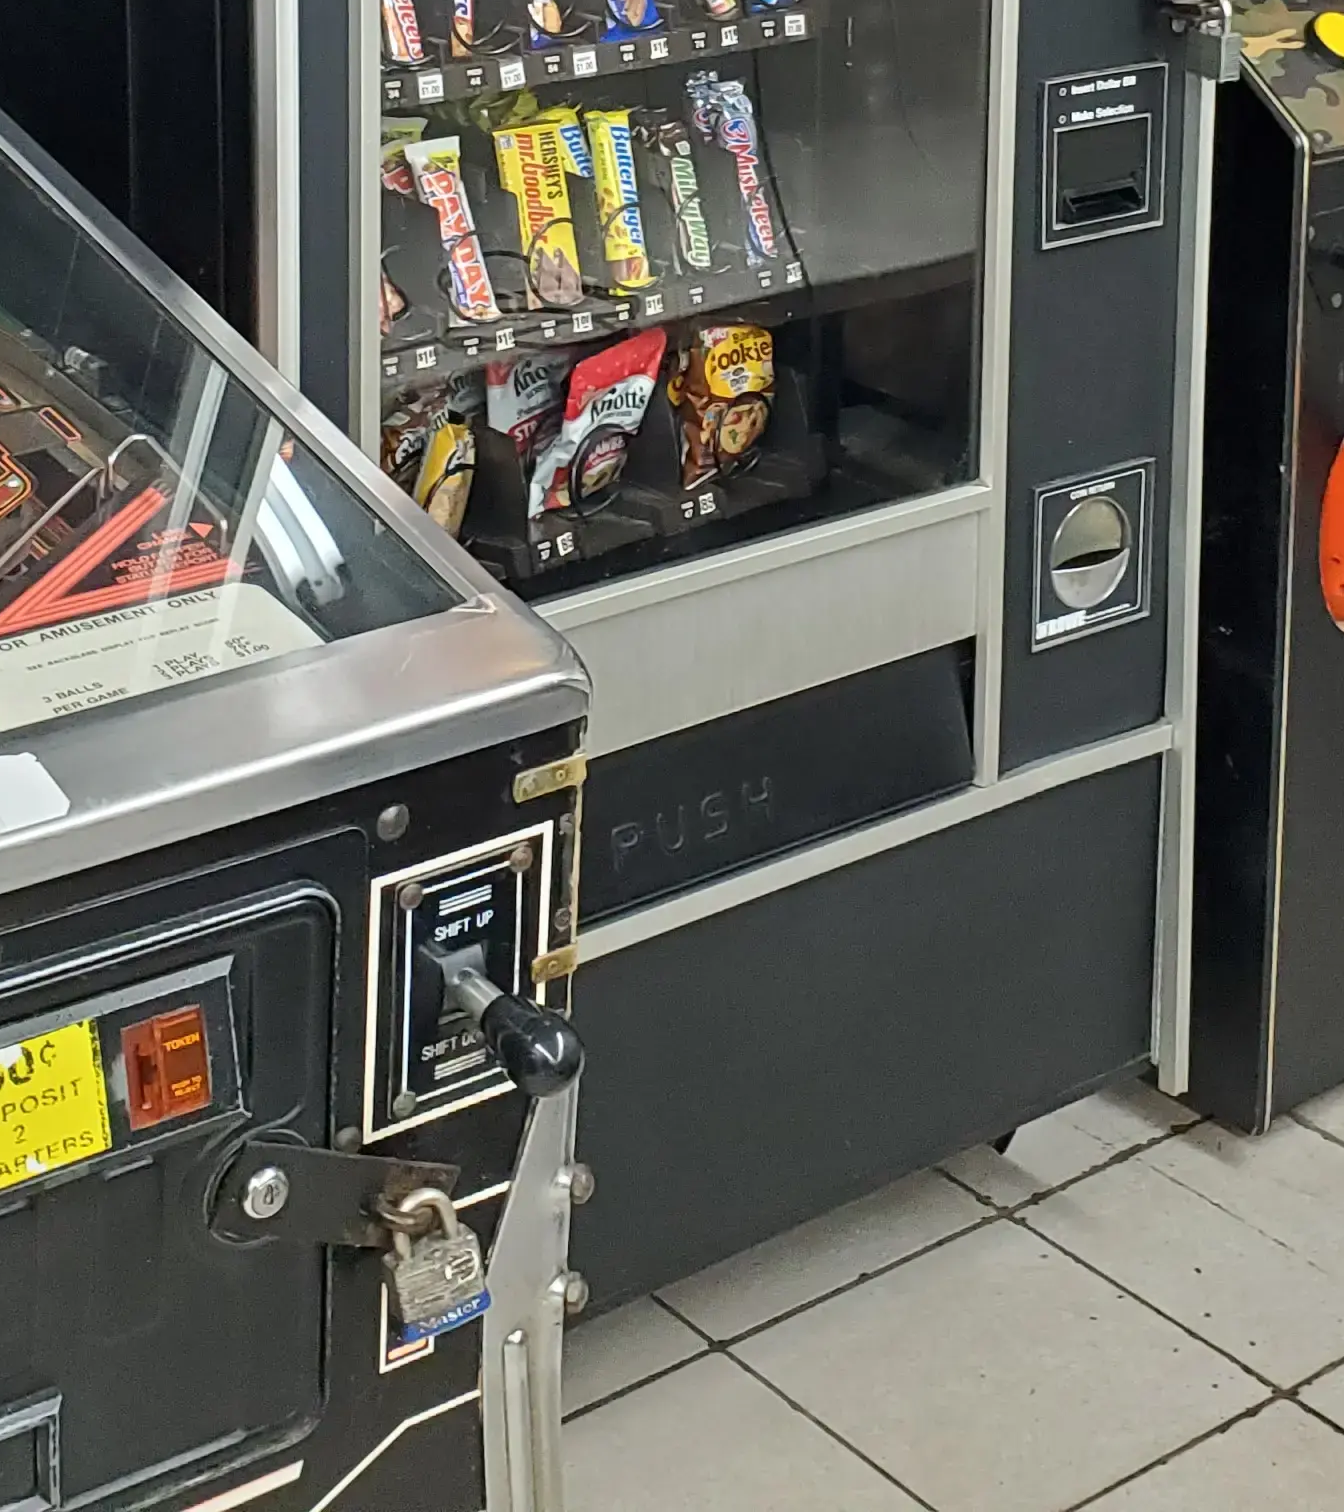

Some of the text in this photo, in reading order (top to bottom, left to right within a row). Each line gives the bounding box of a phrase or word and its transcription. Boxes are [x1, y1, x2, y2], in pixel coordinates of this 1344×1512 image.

[504, 73, 523, 86] $1.00
[575, 61, 594, 73] $1.00
[421, 84, 441, 96] $1.00
[539, 131, 563, 199] HERSHEY'S
[610, 126, 643, 246] Butterfinger
[590, 386, 646, 422] Knott's
[39, 605, 157, 643] AMUSEMENT
[167, 590, 221, 609] ONLY
[165, 651, 201, 668] PLAY
[235, 644, 270, 659] $1.00
[42, 681, 104, 705] 3 BALLS
[52, 686, 129, 715] PER GAME
[610, 775, 774, 875] PUSH
[434, 909, 495, 942] SHIFT UP
[164, 1031, 201, 1052] TOKEN
[420, 1035, 458, 1061] SHIFT
[13, 1124, 27, 1145] 2
[417, 1296, 482, 1333] Master
